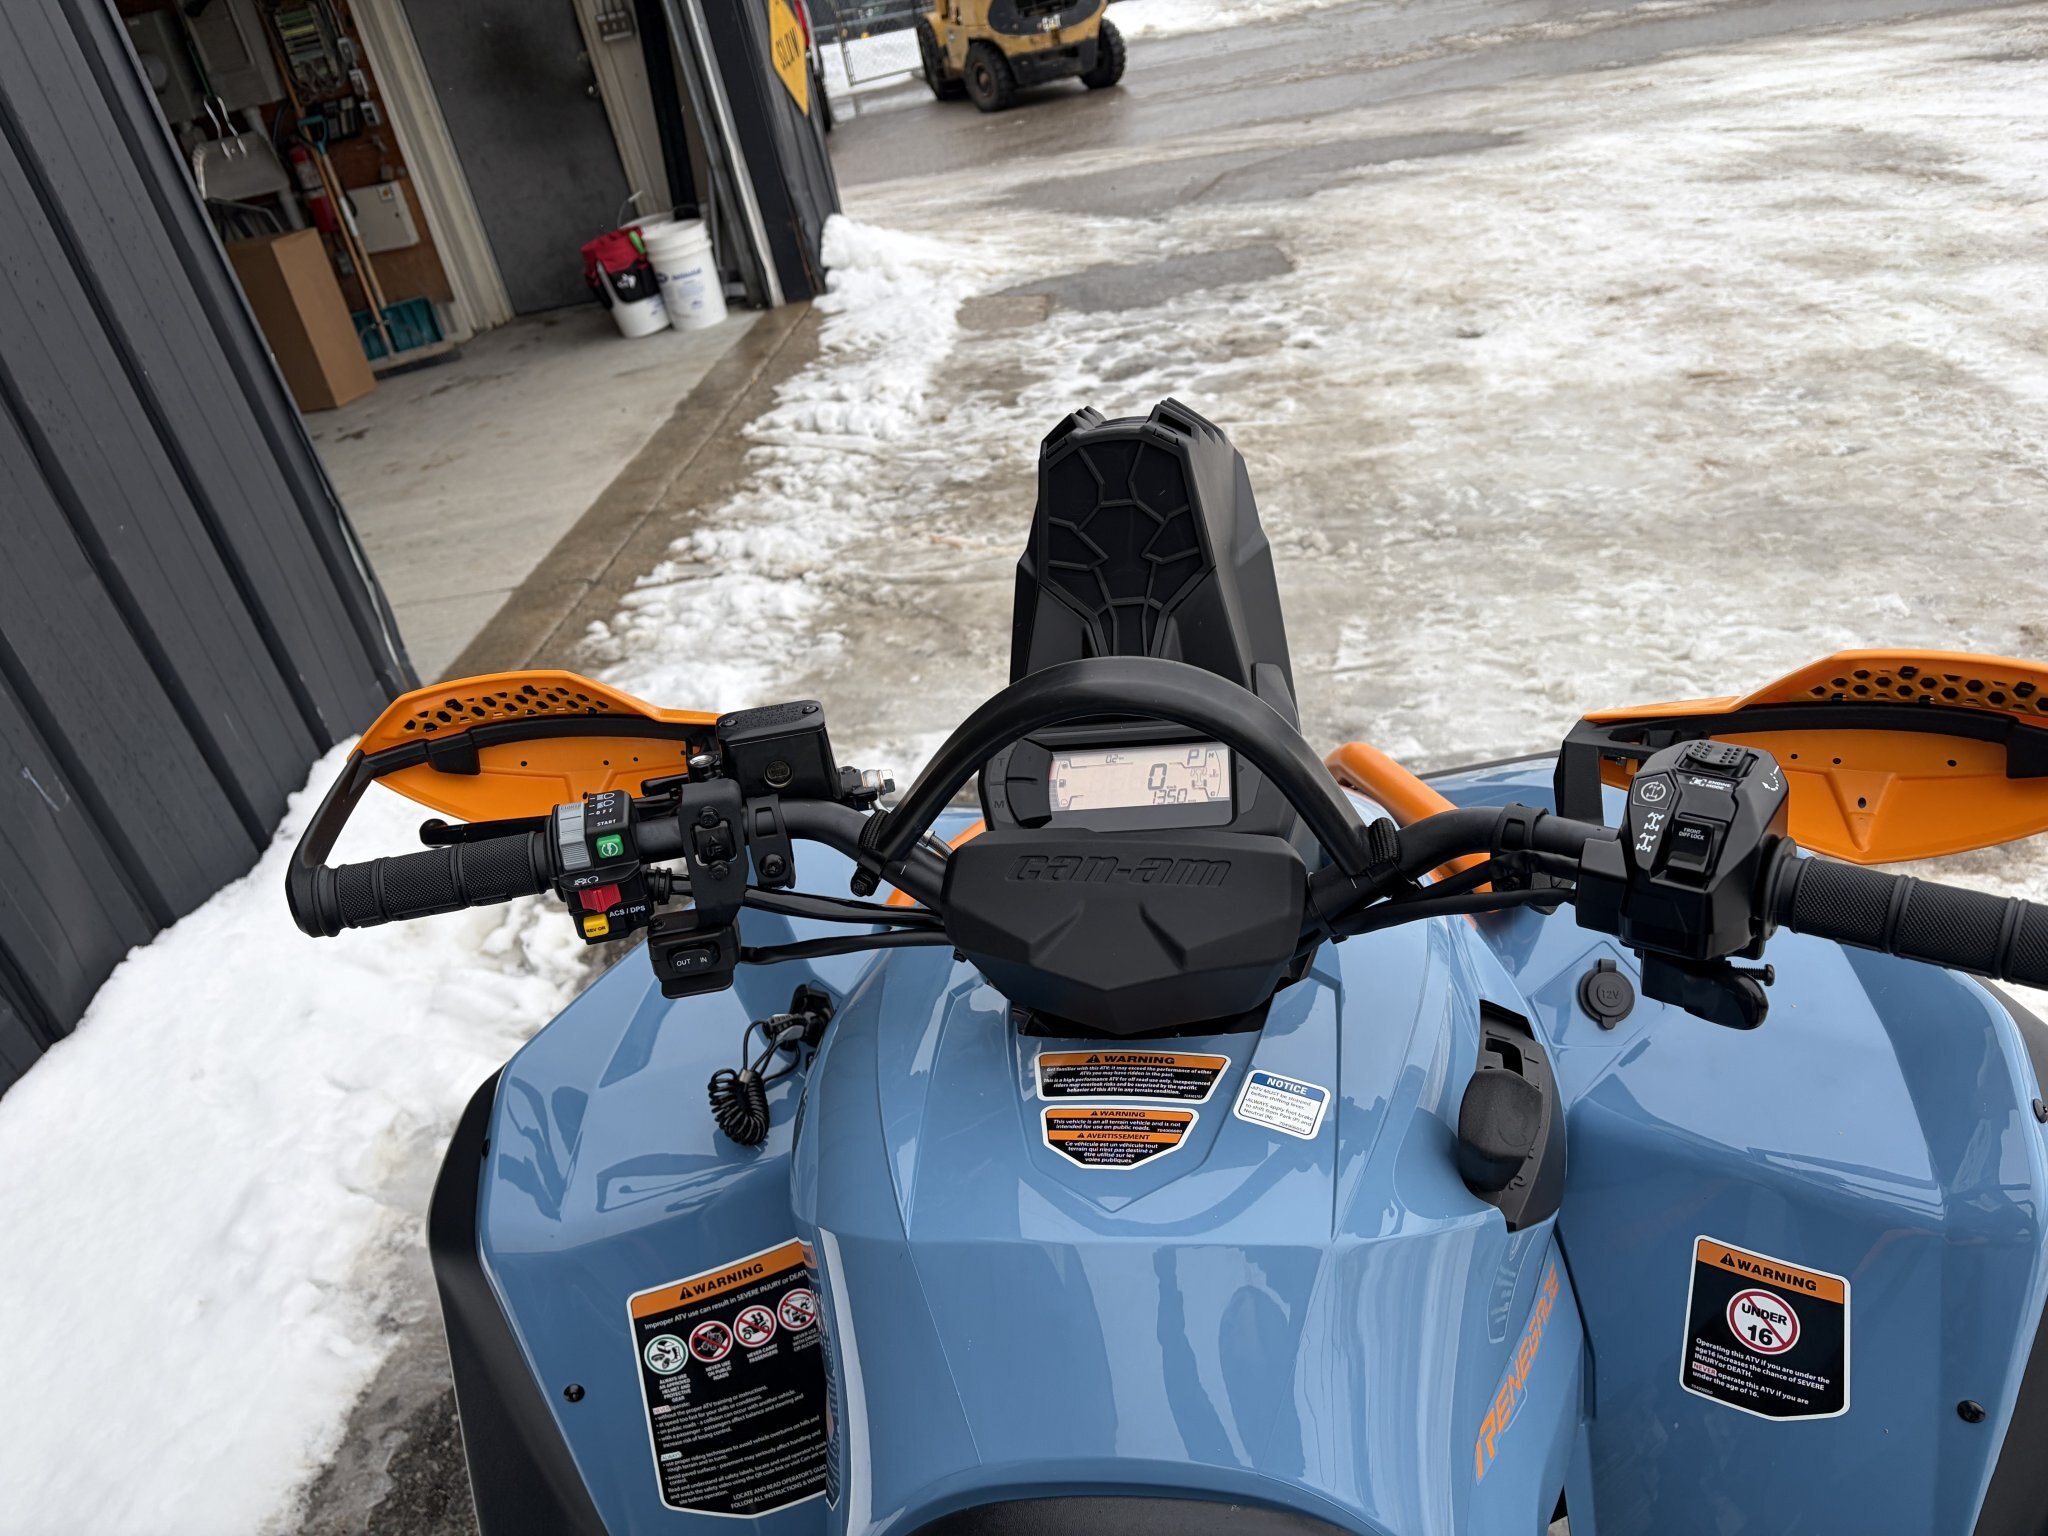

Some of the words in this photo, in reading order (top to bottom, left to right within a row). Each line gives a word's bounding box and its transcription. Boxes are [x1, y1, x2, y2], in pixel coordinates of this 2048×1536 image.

[775, 26, 801, 70] SLOW
[1187, 749, 1199, 765] P
[1148, 763, 1167, 790] 0
[1152, 788, 1187, 804] 1350
[609, 908, 625, 917] ACS
[630, 905, 645, 913] DPS
[1602, 990, 1619, 999] 12V
[1103, 1055, 1176, 1064] WARNING
[1266, 1076, 1308, 1095] NOTICE
[692, 1262, 764, 1295] WARNING
[1736, 1258, 1816, 1291] WARNING
[644, 1314, 673, 1331] Improper
[674, 1311, 687, 1321] ATV
[687, 1309, 698, 1317] use
[699, 1305, 711, 1313] can
[711, 1298, 728, 1309] result
[736, 1287, 759, 1301] SEVERE
[759, 1279, 781, 1292] INJURY
[1741, 1303, 1787, 1325] UNDER
[1747, 1323, 1772, 1346] 16
[762, 1343, 778, 1353] CARRY
[1695, 1337, 1729, 1355] Operating
[1730, 1349, 1744, 1359] this
[1745, 1354, 1760, 1364] ATV
[1766, 1362, 1780, 1371] you
[1794, 1369, 1816, 1380] under
[1817, 1375, 1829, 1384] the
[1476, 1263, 1559, 1478] RENEGADE
[1692, 1371, 1712, 1381] under
[1713, 1377, 1724, 1386] the
[1725, 1382, 1738, 1391] age
[1694, 1362, 1715, 1375] NEVER
[1717, 1372, 1744, 1385] operate
[1745, 1380, 1758, 1390] this
[1760, 1385, 1774, 1394] ATV
[1782, 1393, 1795, 1402] you
[1716, 1352, 1748, 1368] increases
[1749, 1363, 1761, 1372] the
[1762, 1368, 1787, 1380] chance
[1797, 1377, 1824, 1391] SEVERE
[1726, 1363, 1752, 1377] DEATH.
[730, 1498, 753, 1509] FOLLOW
[753, 1494, 763, 1502] ALL
[763, 1481, 803, 1499] INSTRUCTIONS
[806, 1472, 826, 1483] WARNIN
[732, 1489, 753, 1500] LOCATE
[753, 1485, 766, 1494] AND
[766, 1481, 781, 1490] READ
[812, 1463, 827, 1473] GUID
